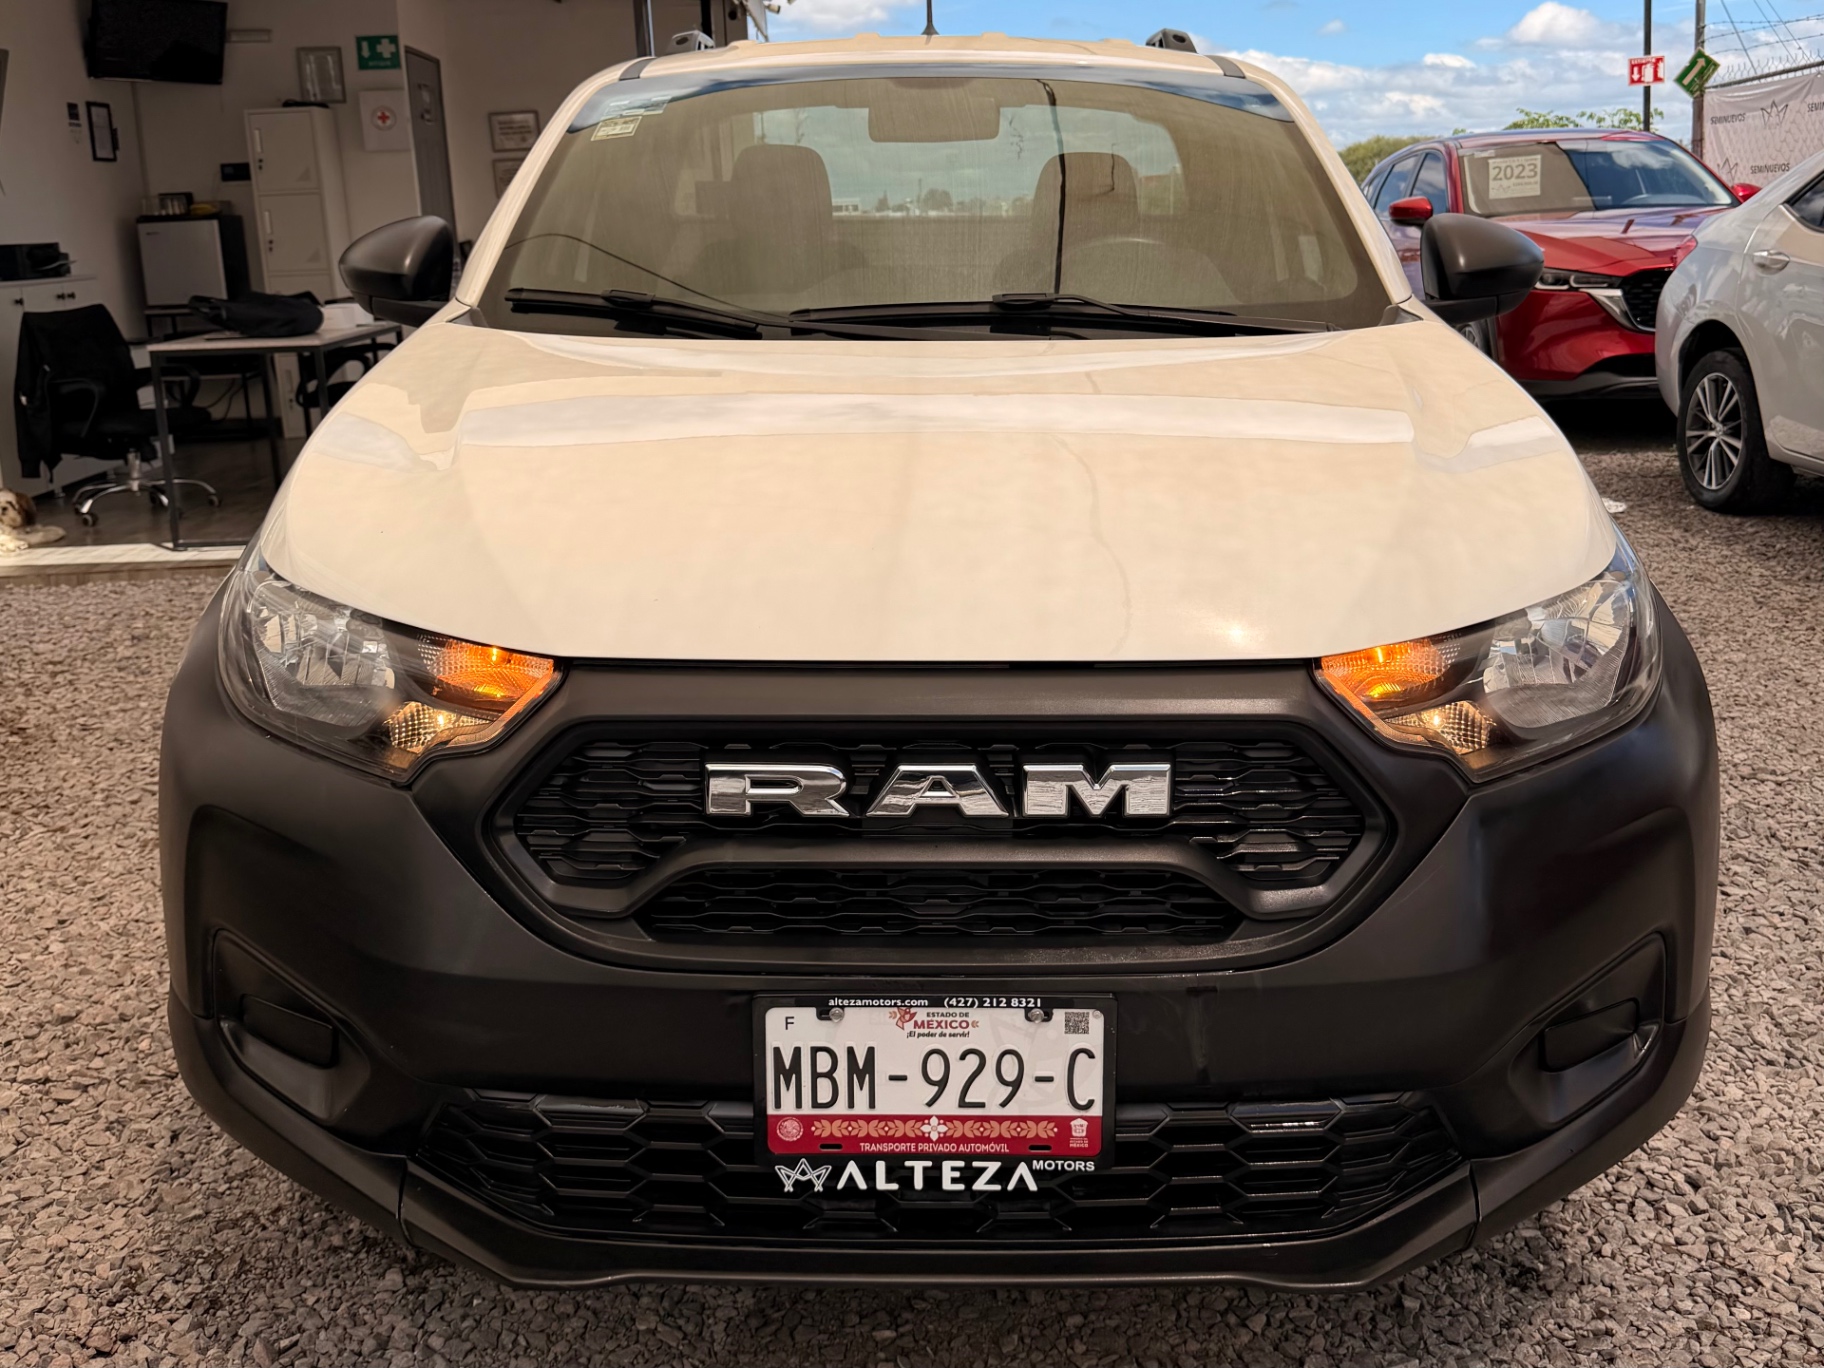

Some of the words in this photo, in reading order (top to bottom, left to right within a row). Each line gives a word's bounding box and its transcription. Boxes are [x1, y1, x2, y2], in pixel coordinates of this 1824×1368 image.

[1710, 113, 1746, 125] SEMINUEVOS
[1491, 162, 1539, 182] 2023
[1750, 163, 1791, 174] SEMINUEVOS
[705, 762, 1173, 818] RAM
[828, 998, 928, 1007] altezamotors.com
[943, 997, 979, 1009] (427)
[982, 997, 1007, 1008] 212
[1010, 998, 1042, 1008] 8321
[784, 1016, 795, 1031] F
[917, 1030, 937, 1039] poder
[938, 1030, 947, 1038] de
[948, 1030, 970, 1038] servir!
[772, 1046, 1097, 1111] MBM-929-C
[859, 1142, 916, 1152] TRANSPORTE
[917, 1142, 957, 1152] PRIVADO
[958, 1141, 1010, 1153] AUTOMÓVIL
[836, 1160, 1039, 1192] ALTEZA
[1032, 1159, 1096, 1172] MOTORS
